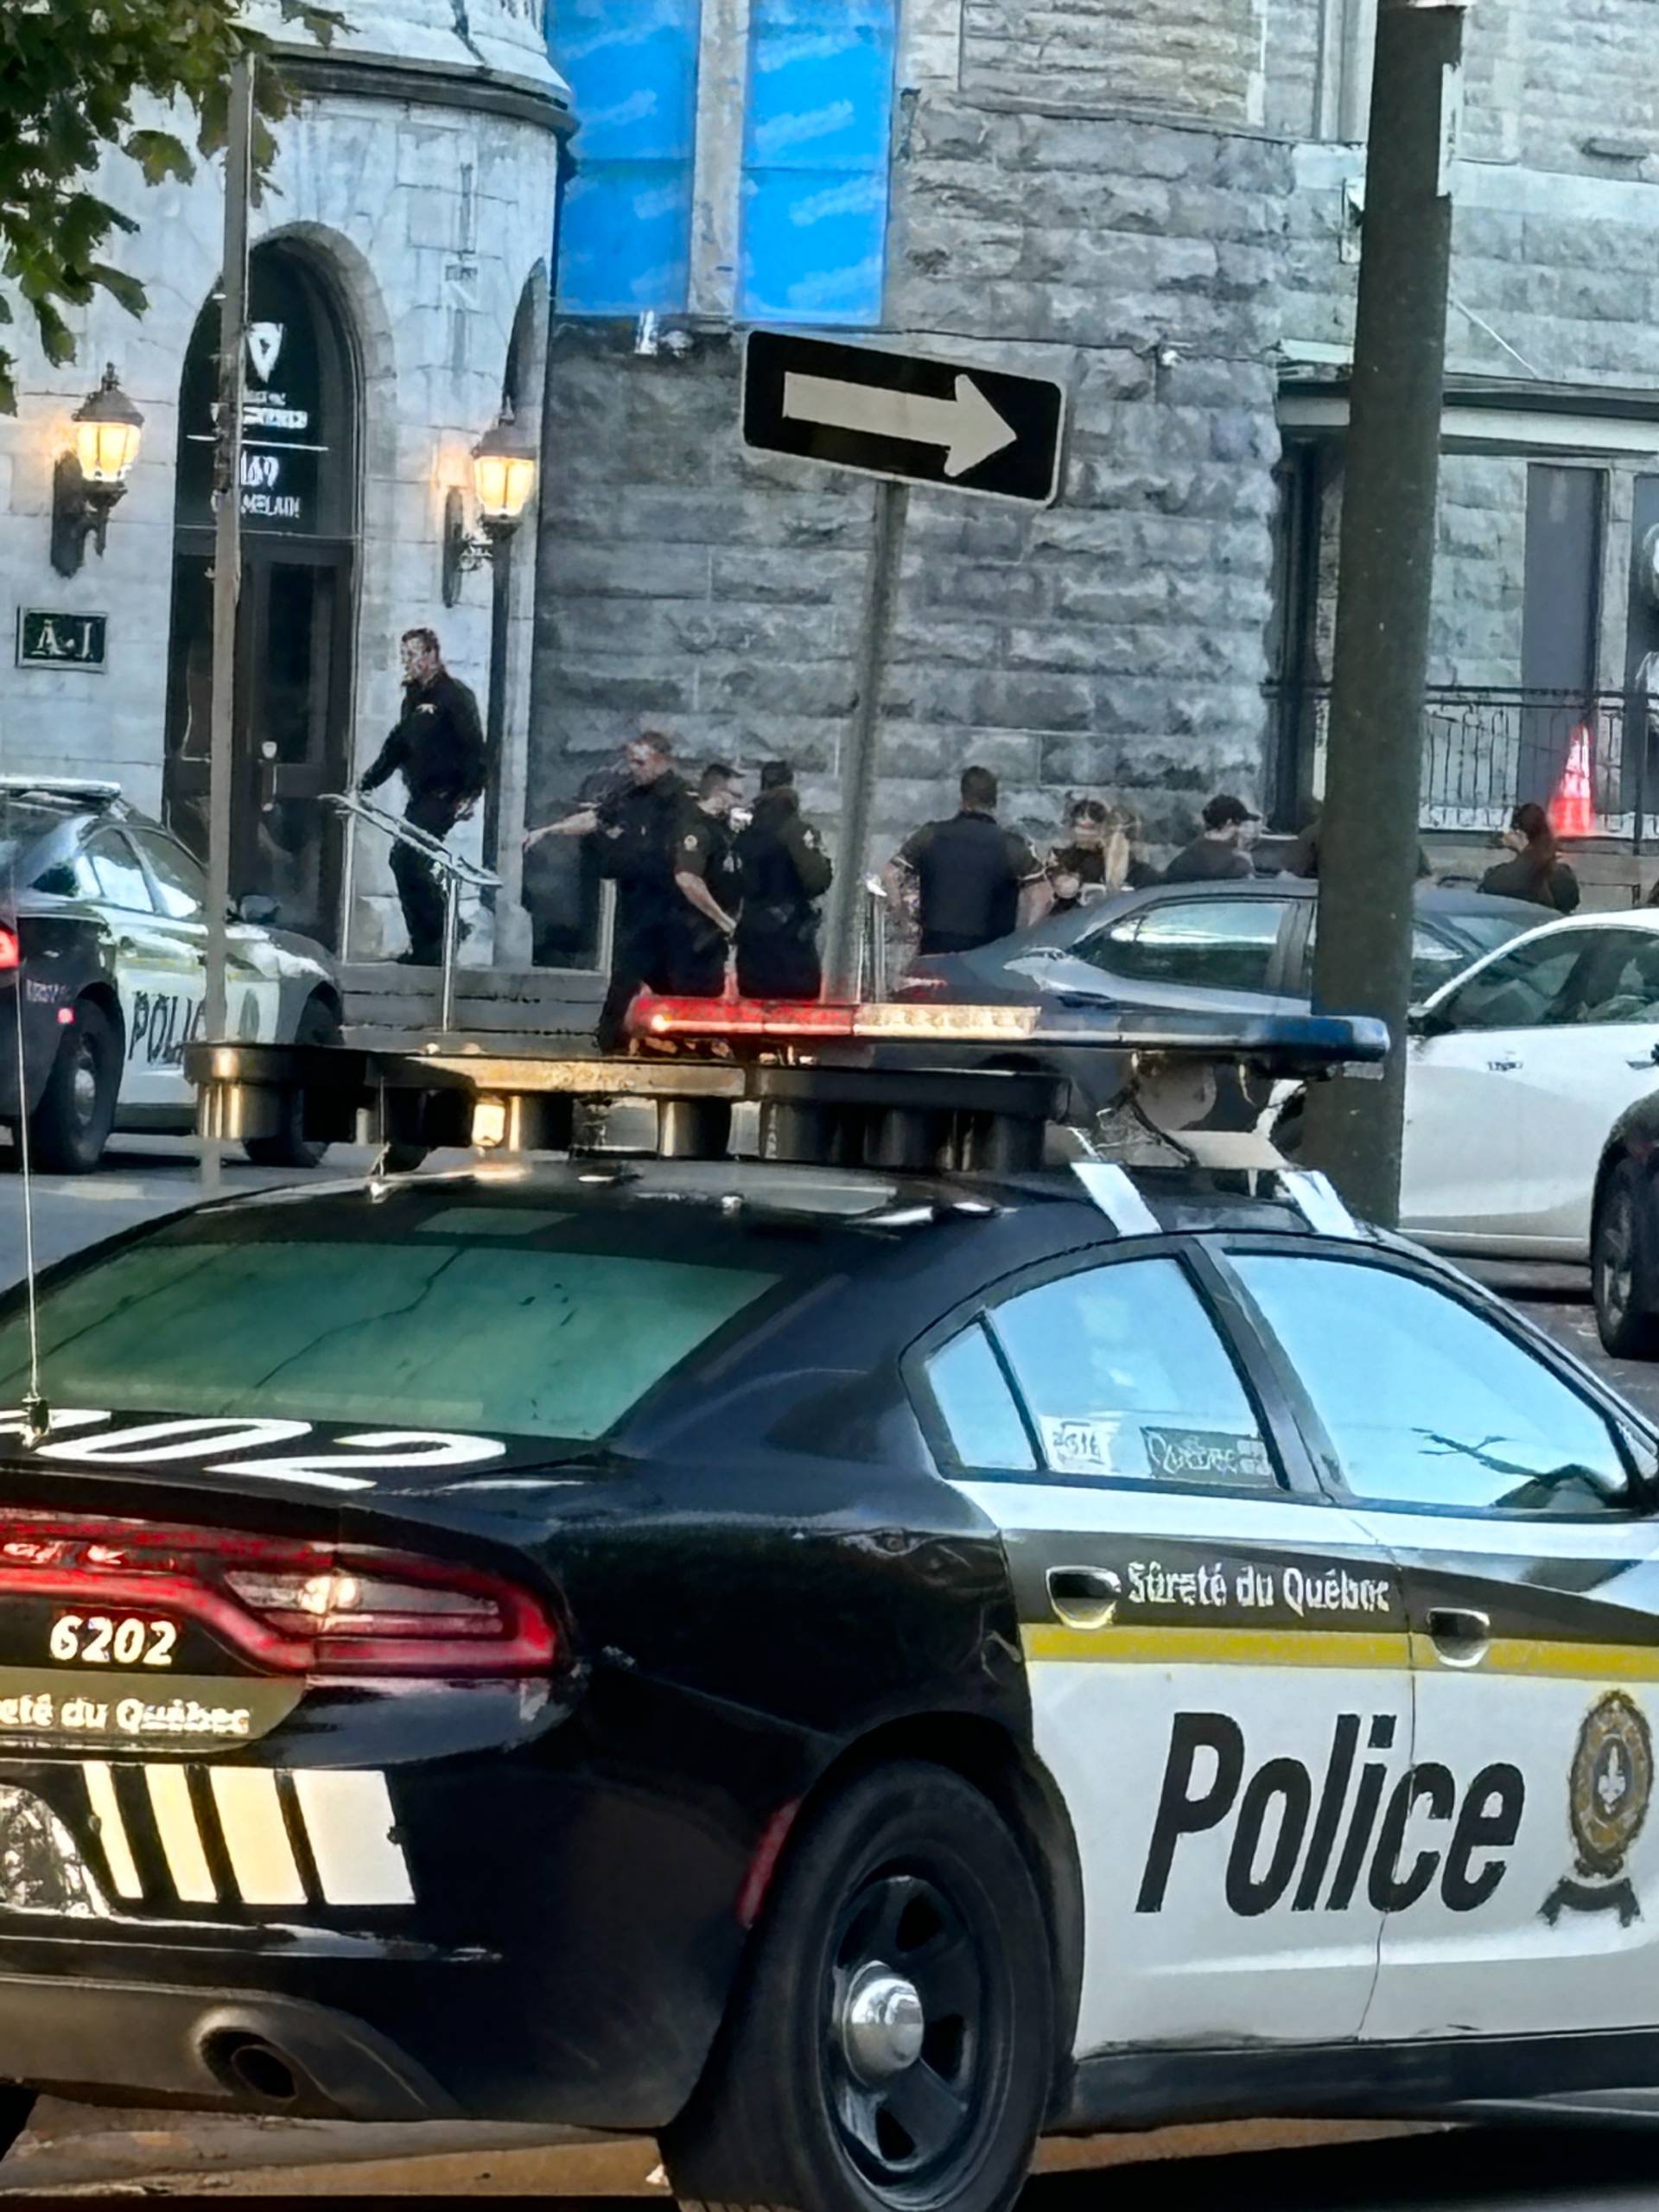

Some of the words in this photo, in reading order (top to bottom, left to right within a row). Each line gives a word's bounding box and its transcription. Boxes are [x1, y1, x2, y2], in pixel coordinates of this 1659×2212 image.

[1128, 1560, 1226, 1605] Sûreté
[1236, 1566, 1274, 1608] du
[1283, 1567, 1389, 1618] Québec
[50, 1615, 176, 1666] 6202
[0, 1694, 53, 1727] eté
[60, 1697, 108, 1729] du
[1135, 1713, 1525, 1916] Police
